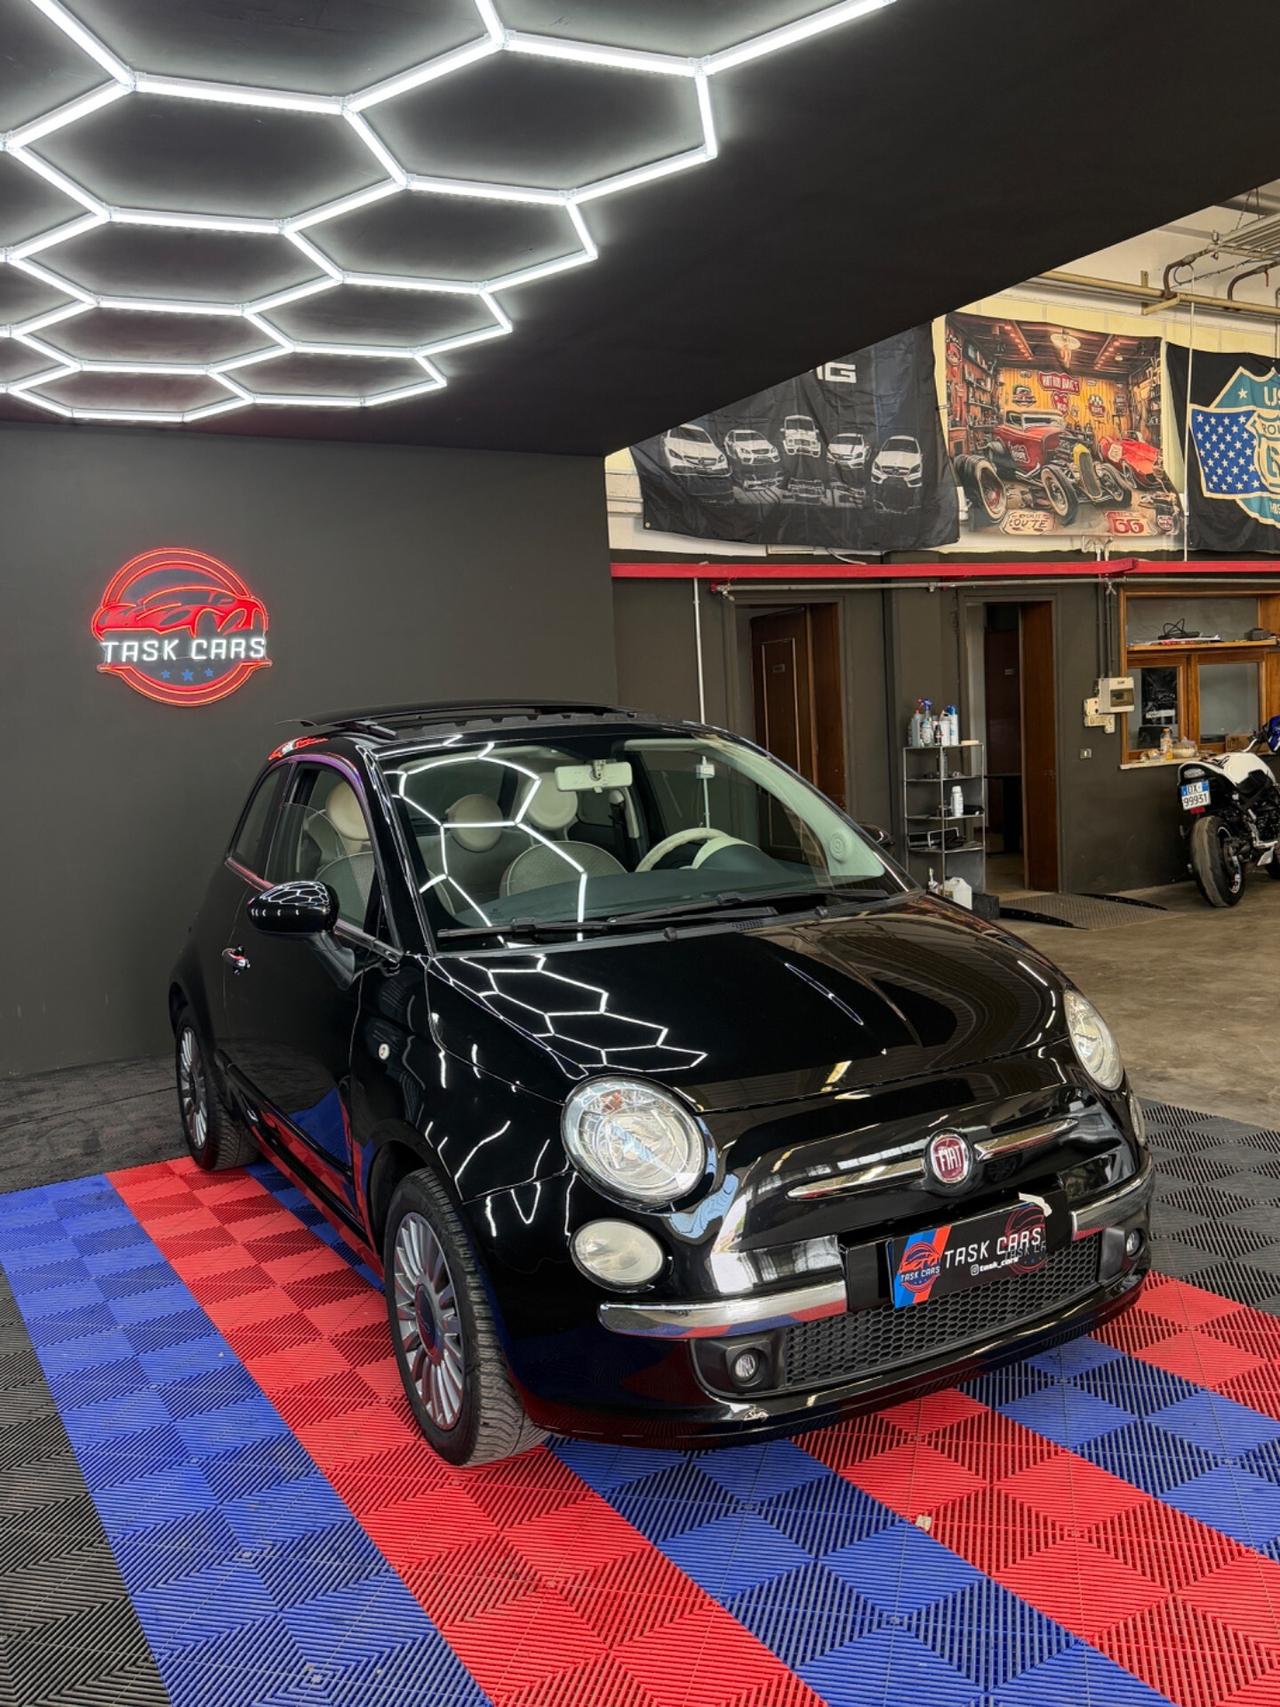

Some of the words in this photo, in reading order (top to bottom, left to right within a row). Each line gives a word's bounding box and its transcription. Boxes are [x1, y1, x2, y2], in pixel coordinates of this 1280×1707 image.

[101, 639, 179, 663] TASK
[191, 637, 265, 660] CARS
[936, 1146, 962, 1171] FIAT
[945, 1240, 990, 1268] TASK
[997, 1227, 1041, 1255] CARS
[901, 1270, 919, 1282] TASK
[921, 1266, 941, 1278] CARS
